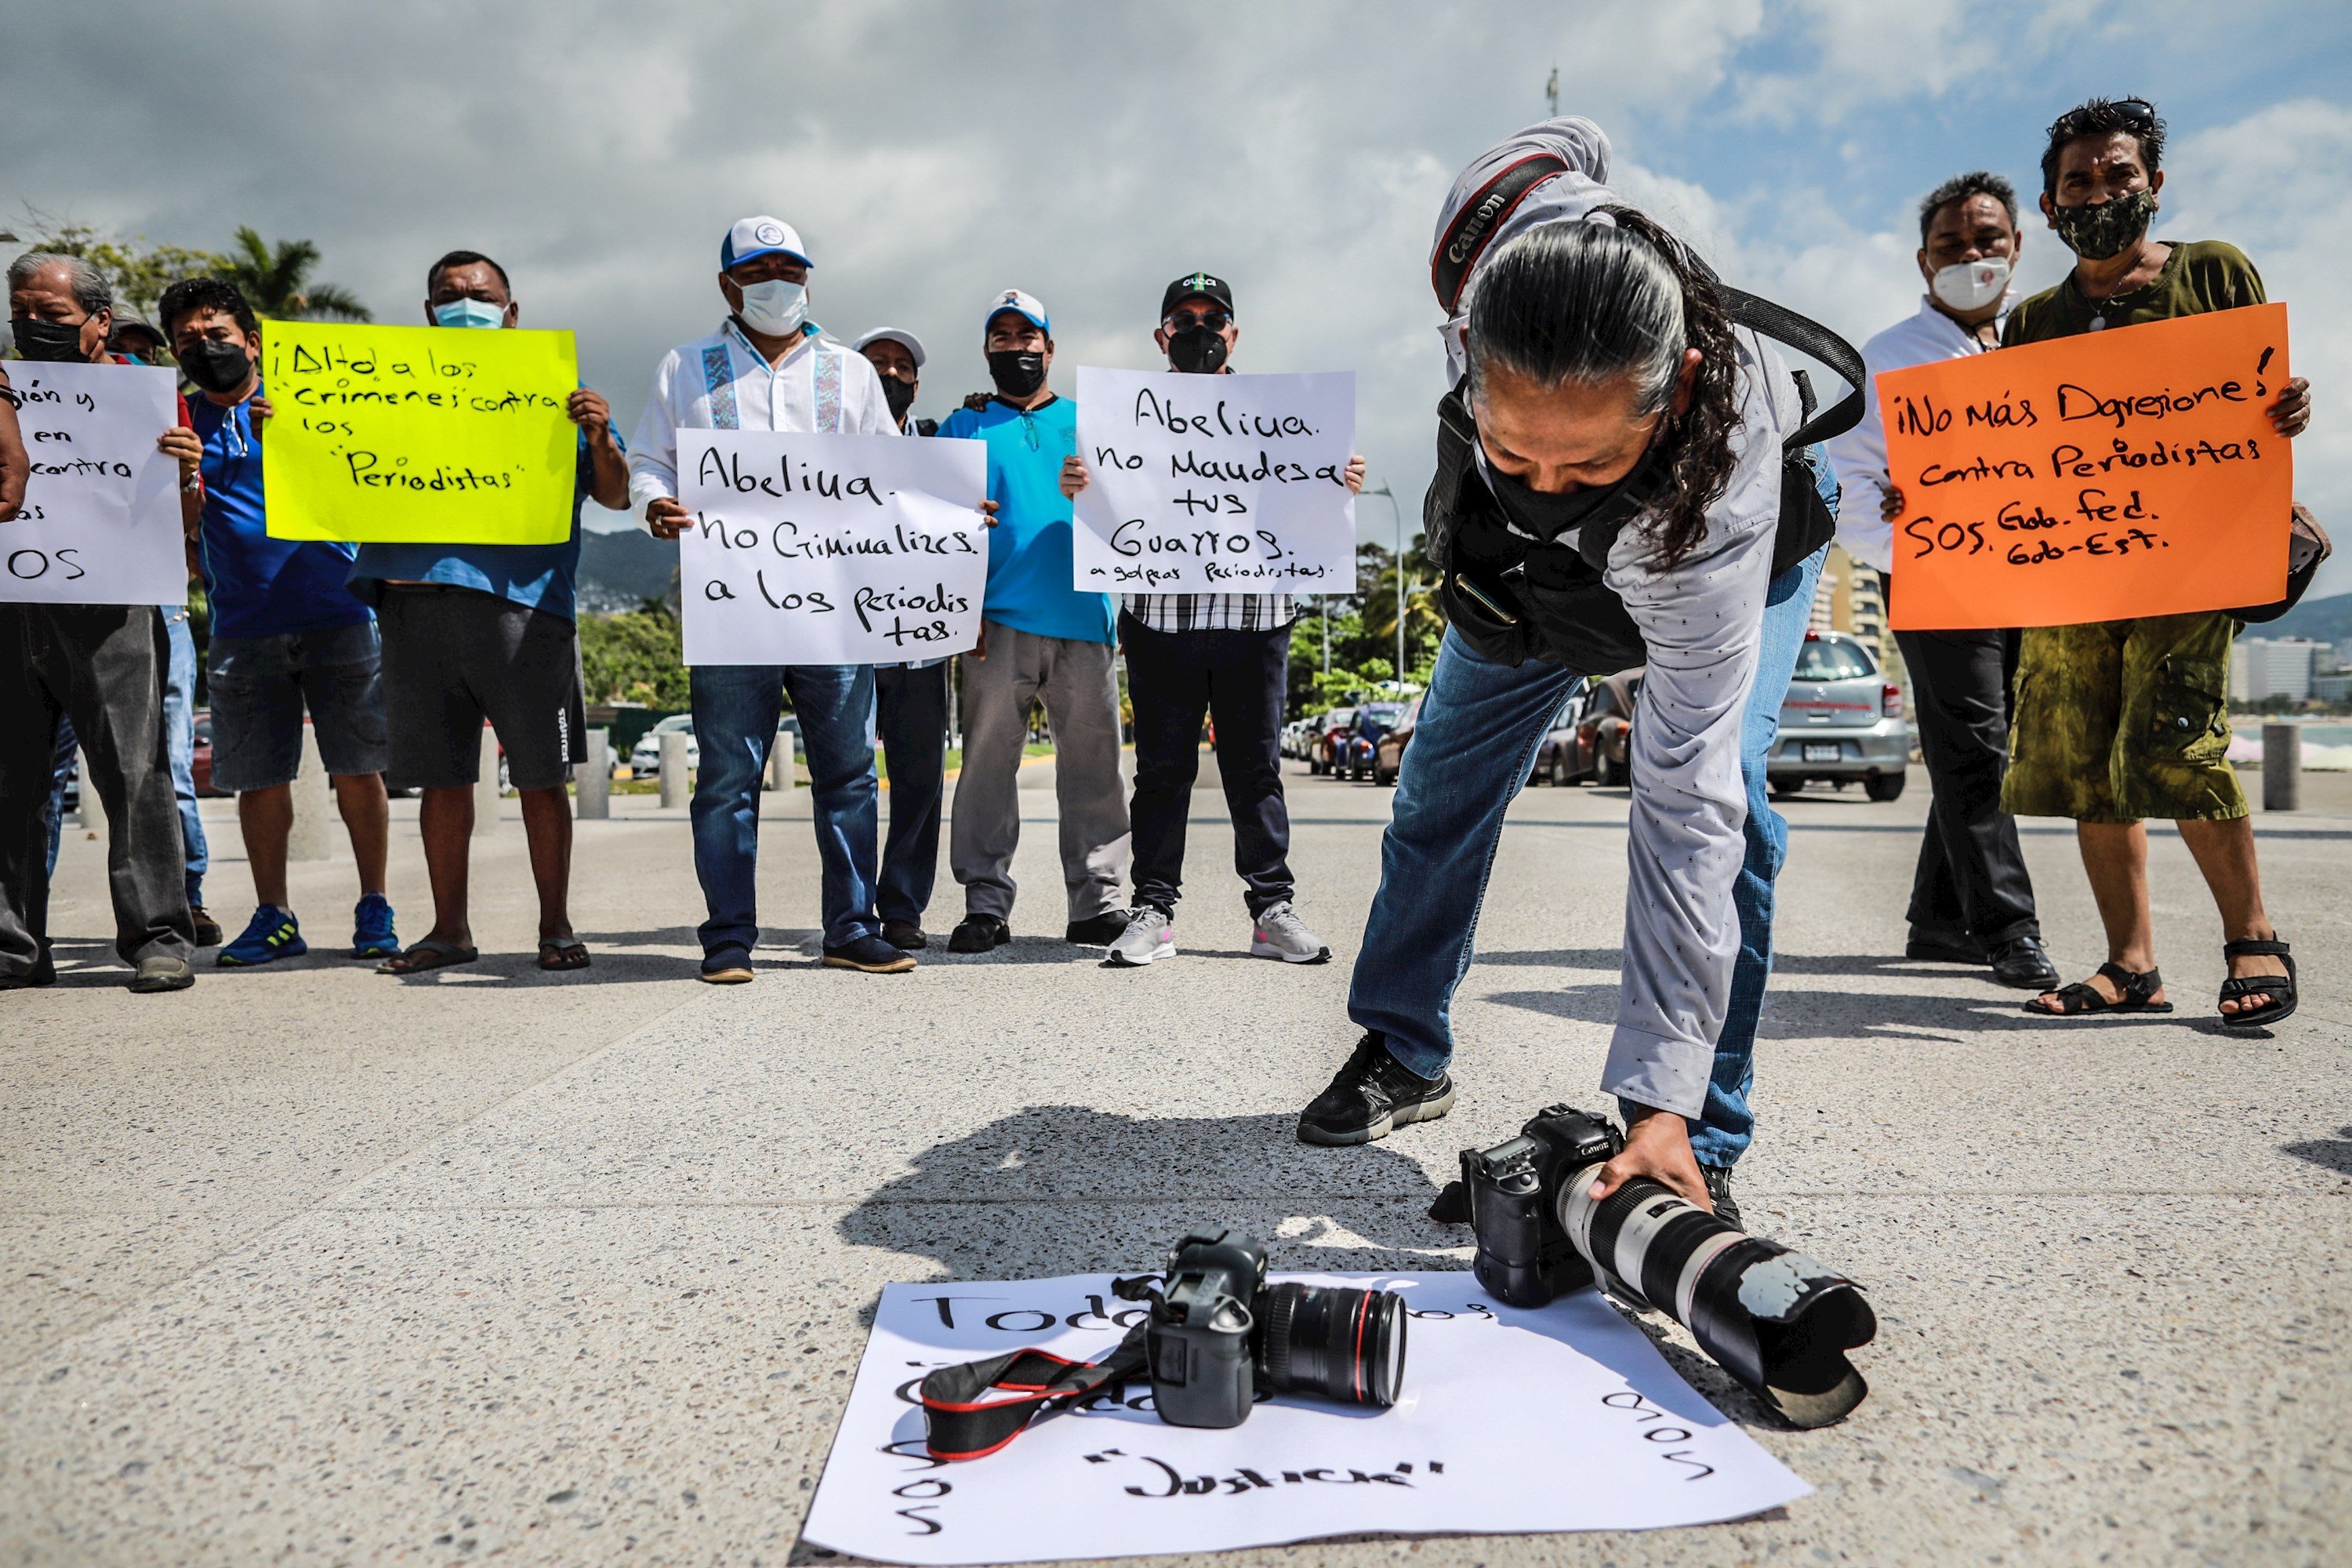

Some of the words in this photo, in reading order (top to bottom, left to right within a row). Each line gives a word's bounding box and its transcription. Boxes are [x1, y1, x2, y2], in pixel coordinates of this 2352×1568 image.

[1448, 193, 1505, 264] Canon
[1182, 278, 1217, 287] GUCCI
[392, 362, 417, 380] a
[427, 347, 477, 379] los
[470, 390, 559, 413] contra
[34, 431, 72, 443] en
[303, 417, 354, 437] los
[30, 457, 132, 479] contra
[2051, 437, 2261, 478] Periodistas
[1172, 488, 1247, 517] tus
[705, 579, 736, 601] a
[757, 569, 835, 613] los
[1581, 1141, 1610, 1156] Canon
